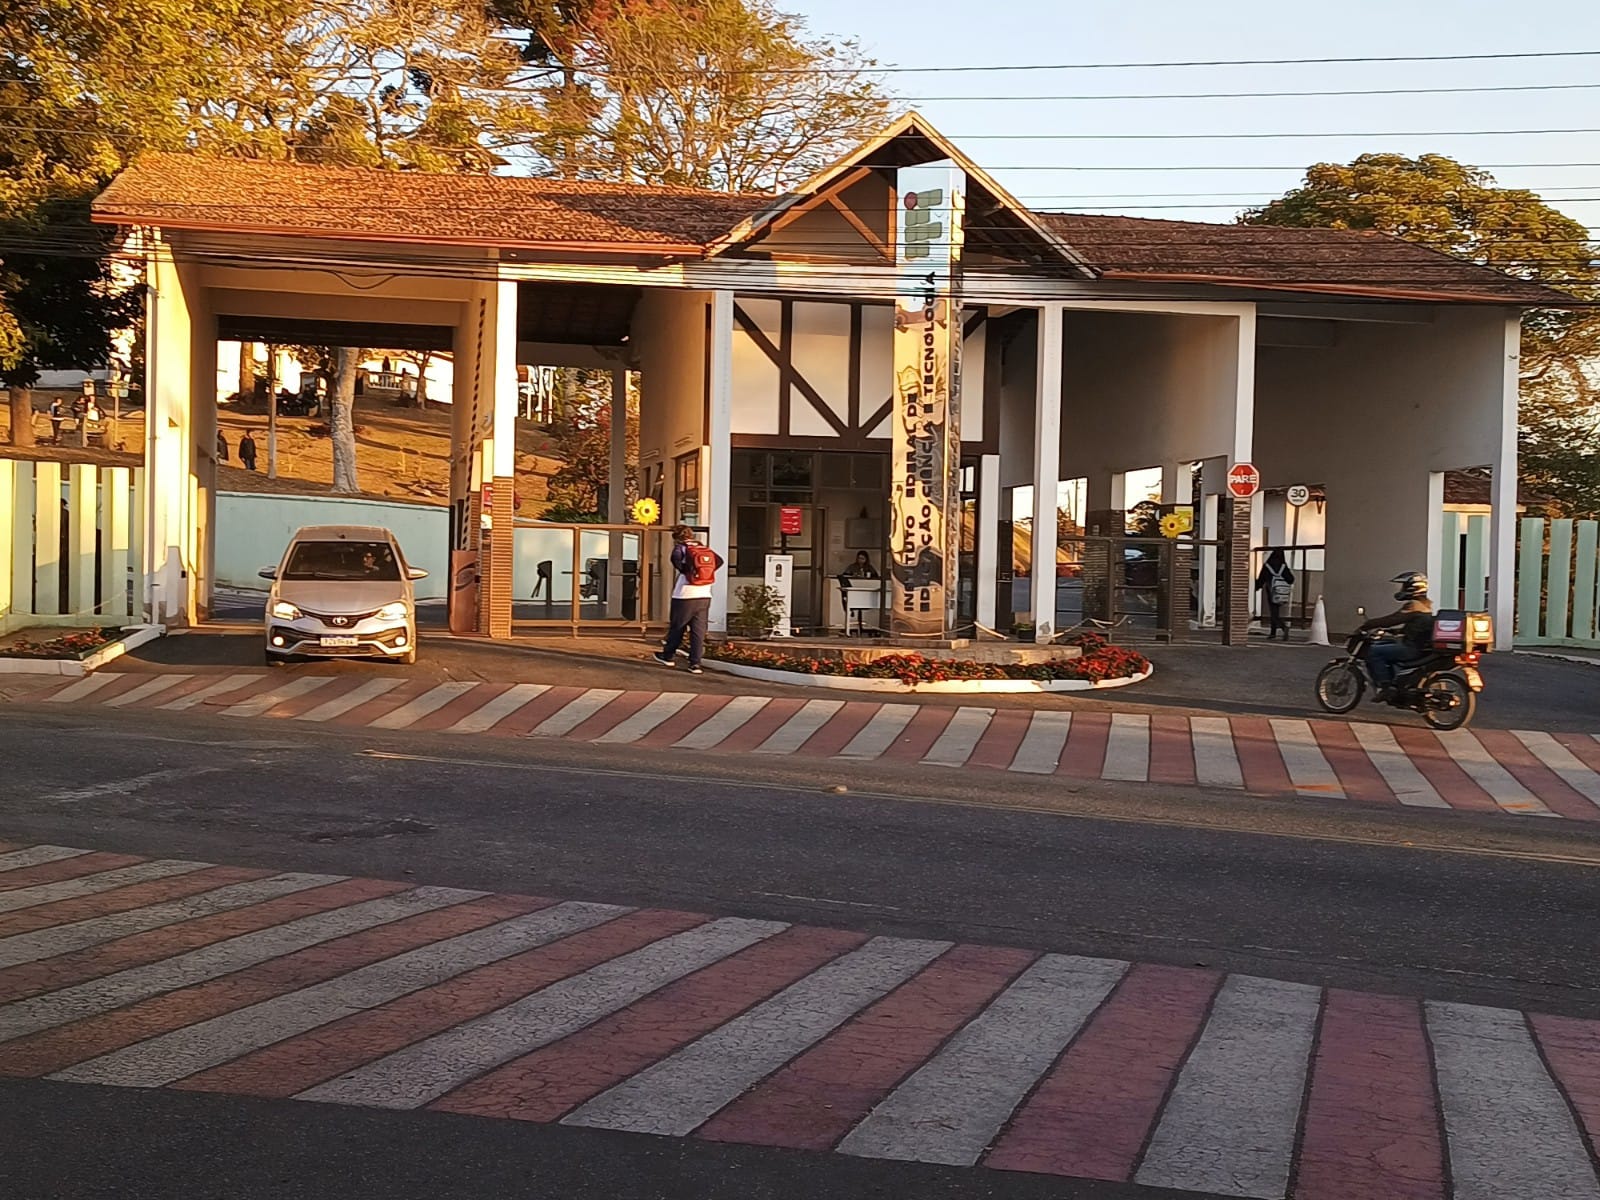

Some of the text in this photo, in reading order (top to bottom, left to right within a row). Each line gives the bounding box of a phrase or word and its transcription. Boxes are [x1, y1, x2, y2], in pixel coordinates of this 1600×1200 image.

[923, 272, 935, 396] TECNOLOGIA
[907, 393, 917, 417] DE
[924, 403, 934, 414] E
[1230, 474, 1257, 484] PARE
[1290, 488, 1306, 498] 30
[904, 516, 915, 612] INSTUTO
